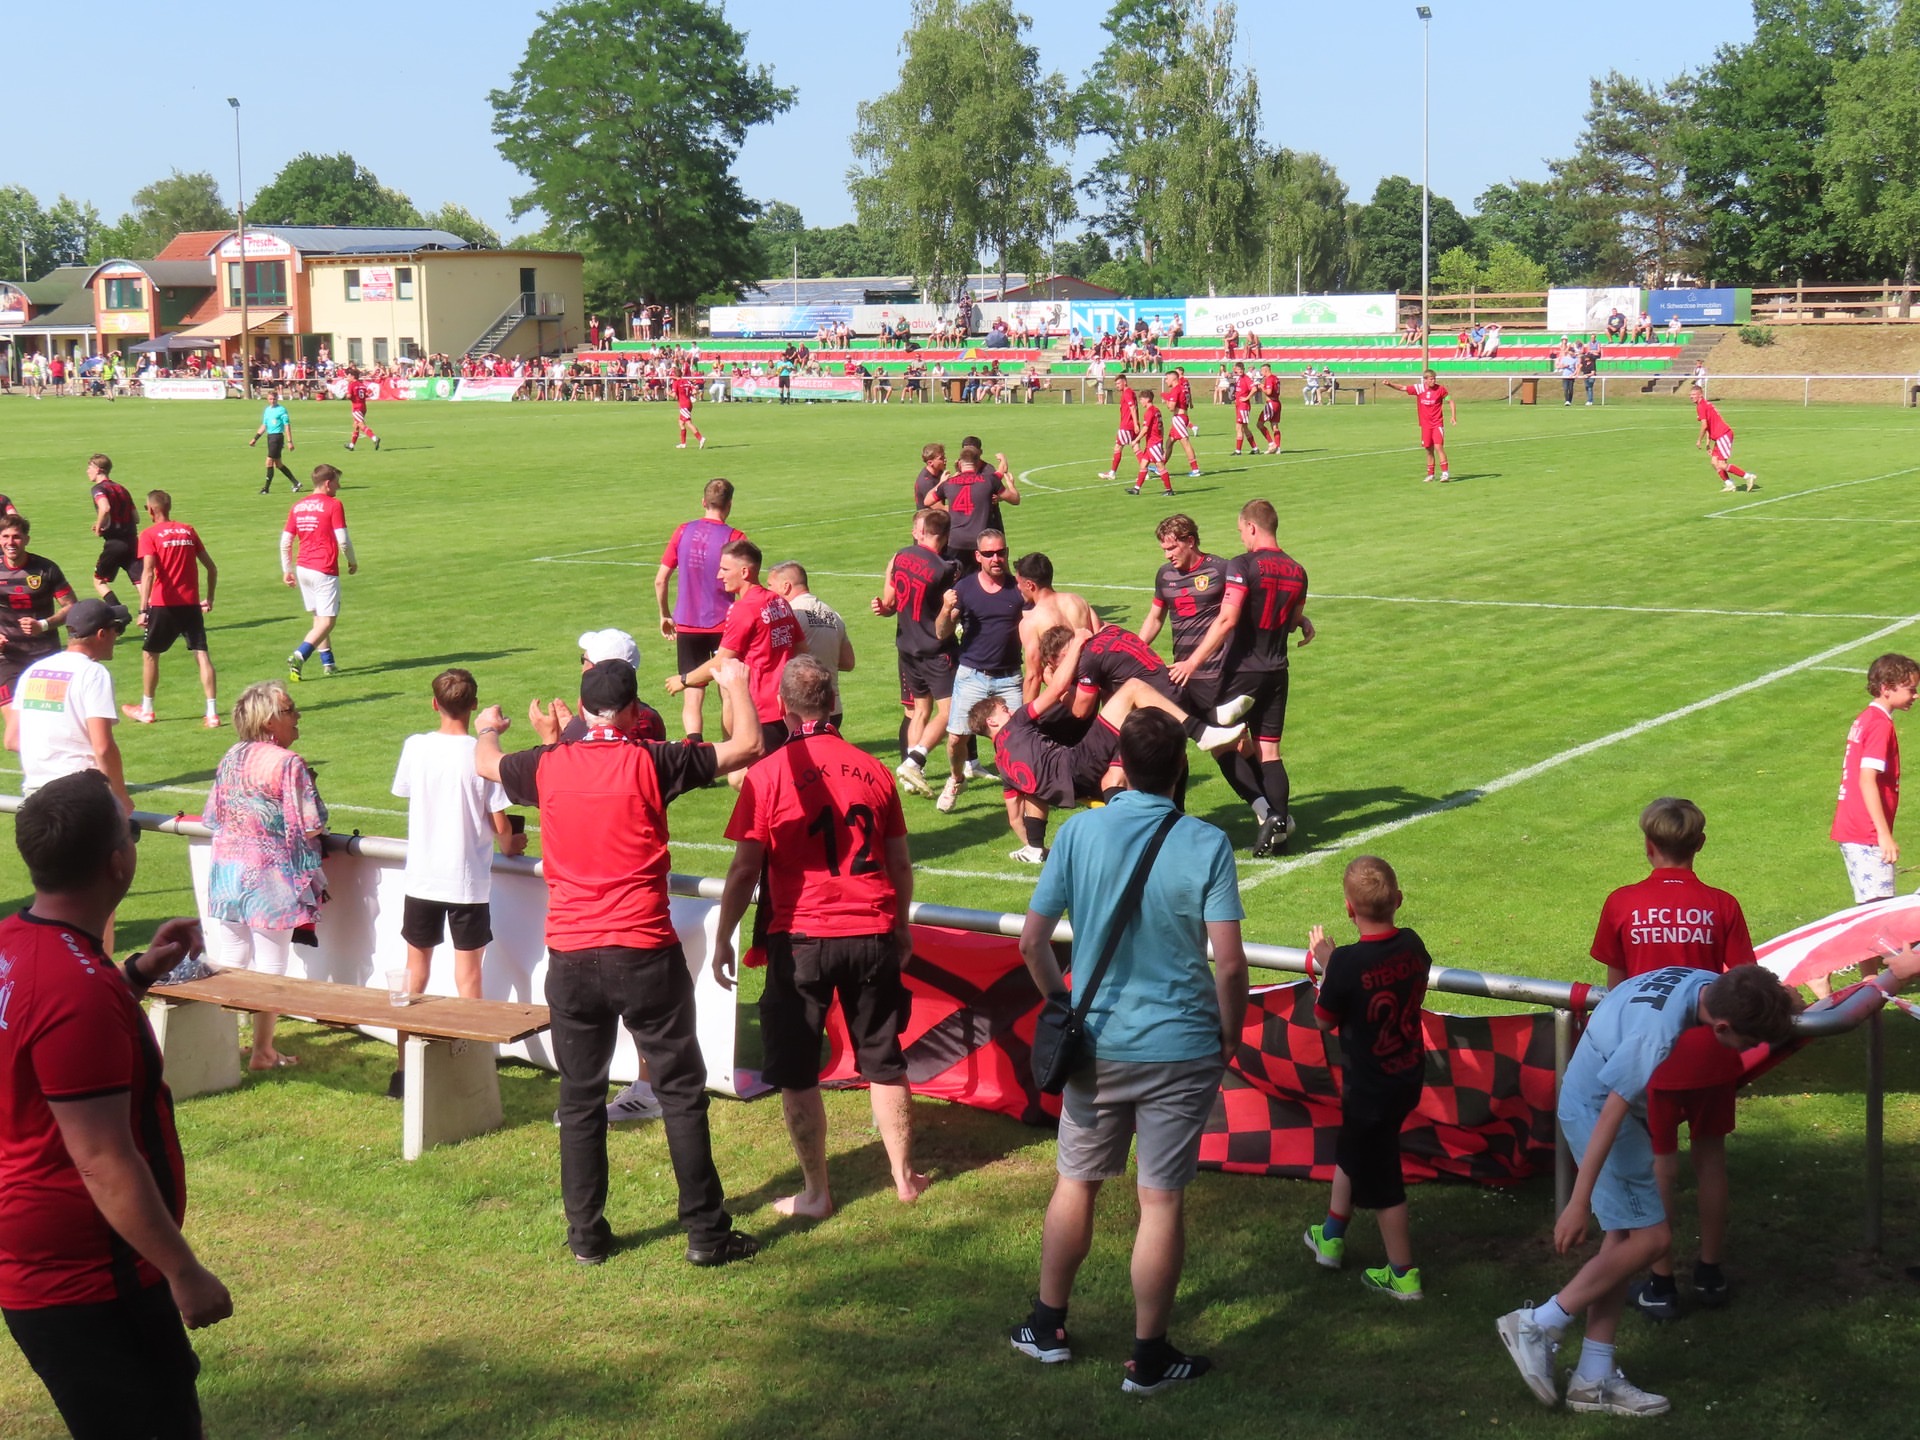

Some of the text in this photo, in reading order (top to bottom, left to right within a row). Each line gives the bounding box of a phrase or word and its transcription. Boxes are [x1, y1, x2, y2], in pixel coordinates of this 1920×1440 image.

[1072, 308, 1136, 338] NTN
[1215, 310, 1241, 321] Telefon
[951, 485, 975, 517] 4
[894, 571, 927, 622] 97
[1258, 577, 1303, 630] 17
[793, 764, 875, 791] LOK FAN
[807, 803, 882, 877] 12
[1631, 908, 1714, 926] 1.FC LOK
[1630, 927, 1714, 945] STENDAL
